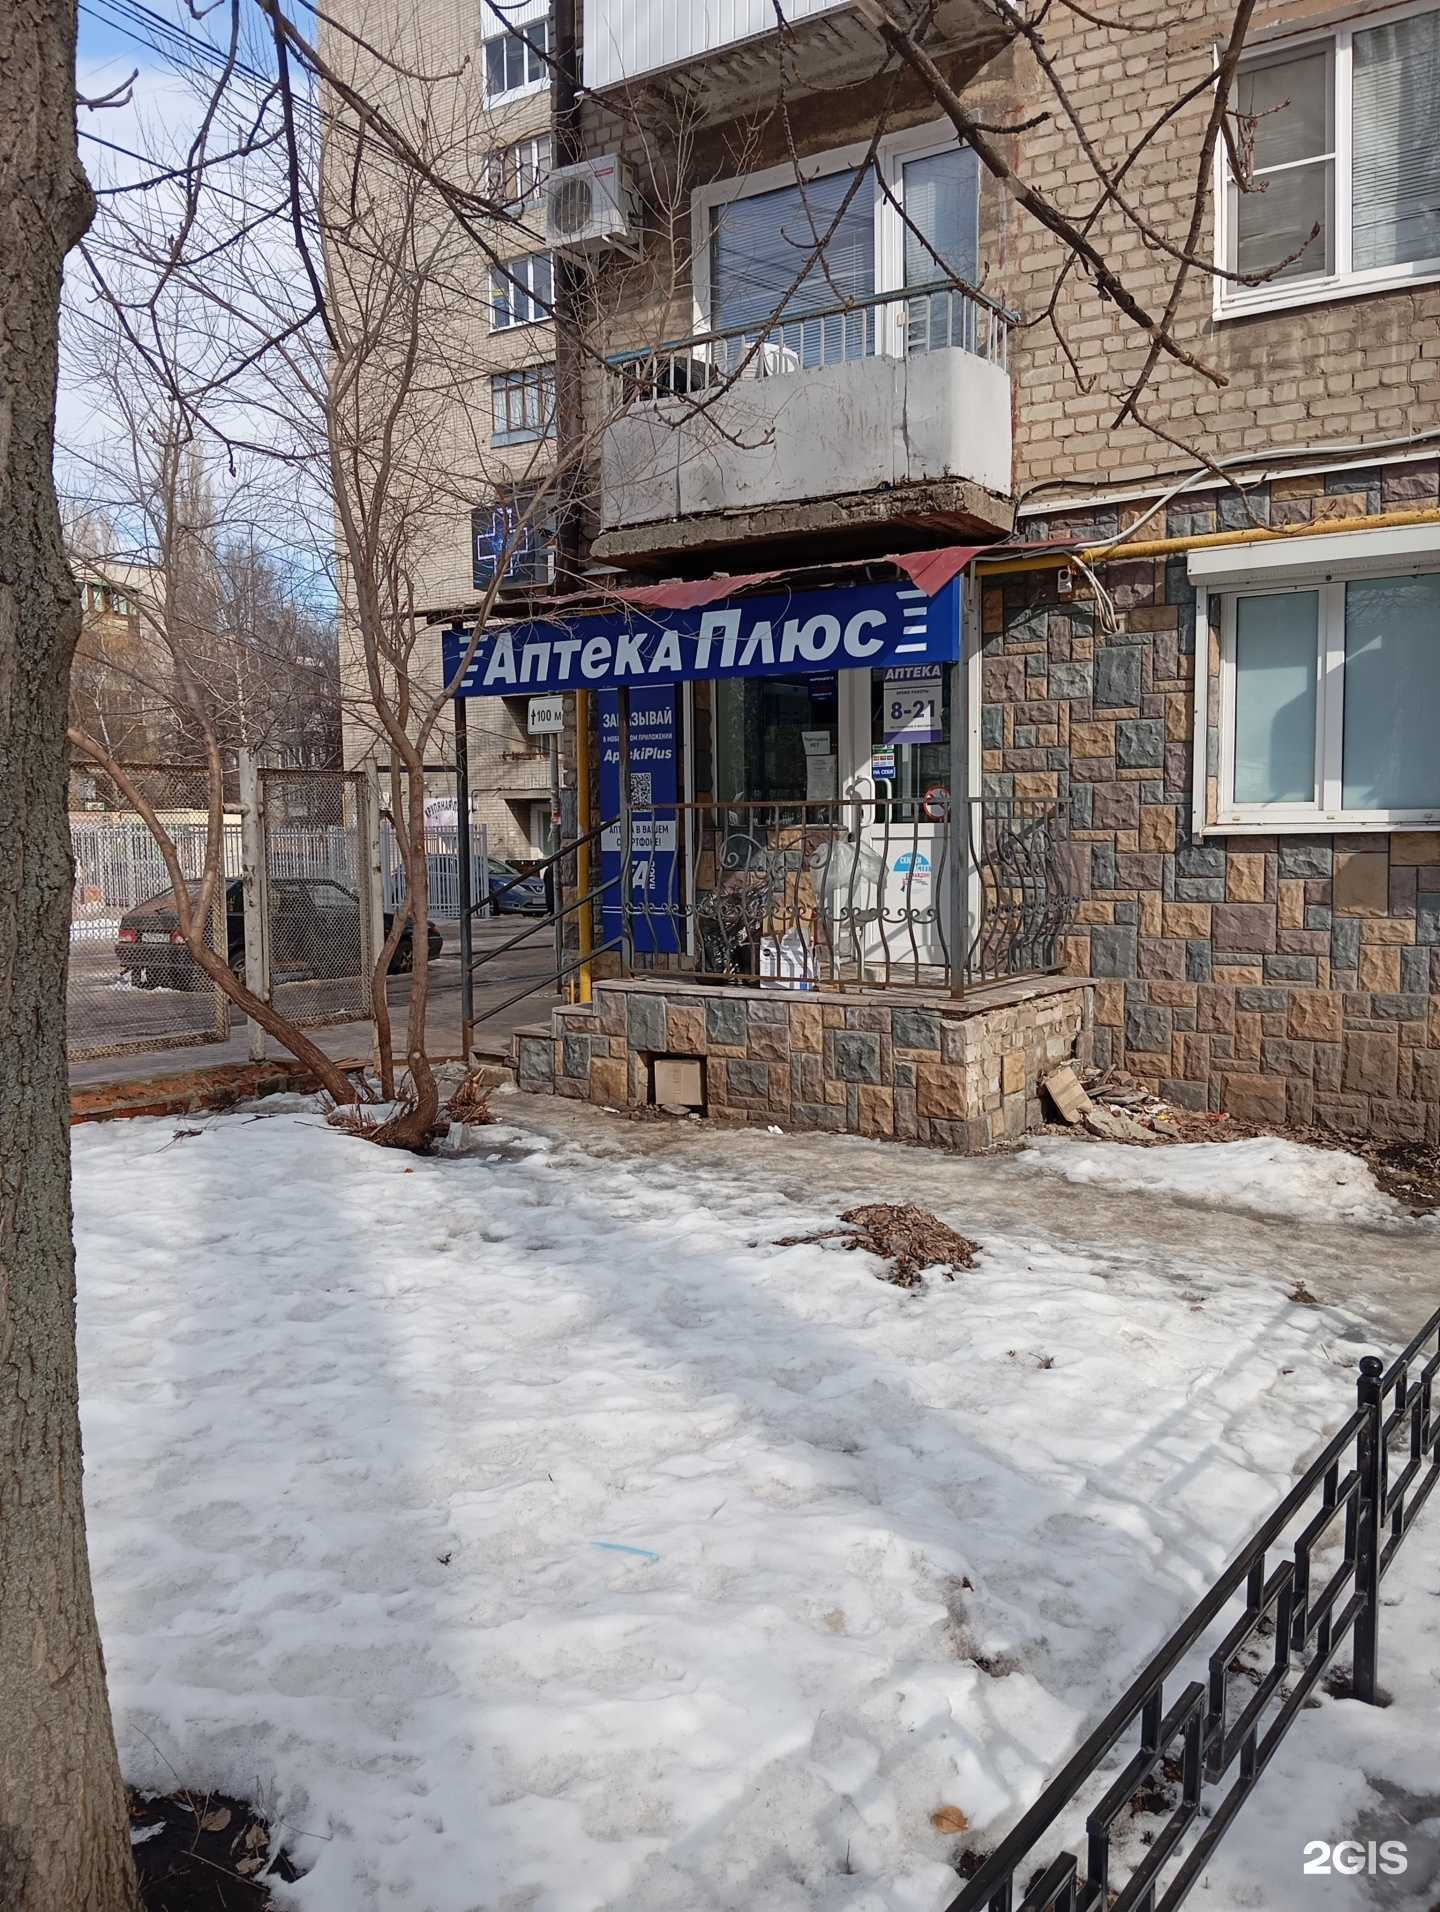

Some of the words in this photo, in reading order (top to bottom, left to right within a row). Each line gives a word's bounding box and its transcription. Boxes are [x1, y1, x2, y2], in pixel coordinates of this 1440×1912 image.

[885, 665, 941, 680] АПТЕКА
[537, 709, 551, 722] 100
[603, 706, 672, 728] ЗАЗЫВАЙ
[891, 700, 935, 720] 8-21
[604, 747, 672, 764] ApkiPlus
[609, 825, 635, 835] АПТА
